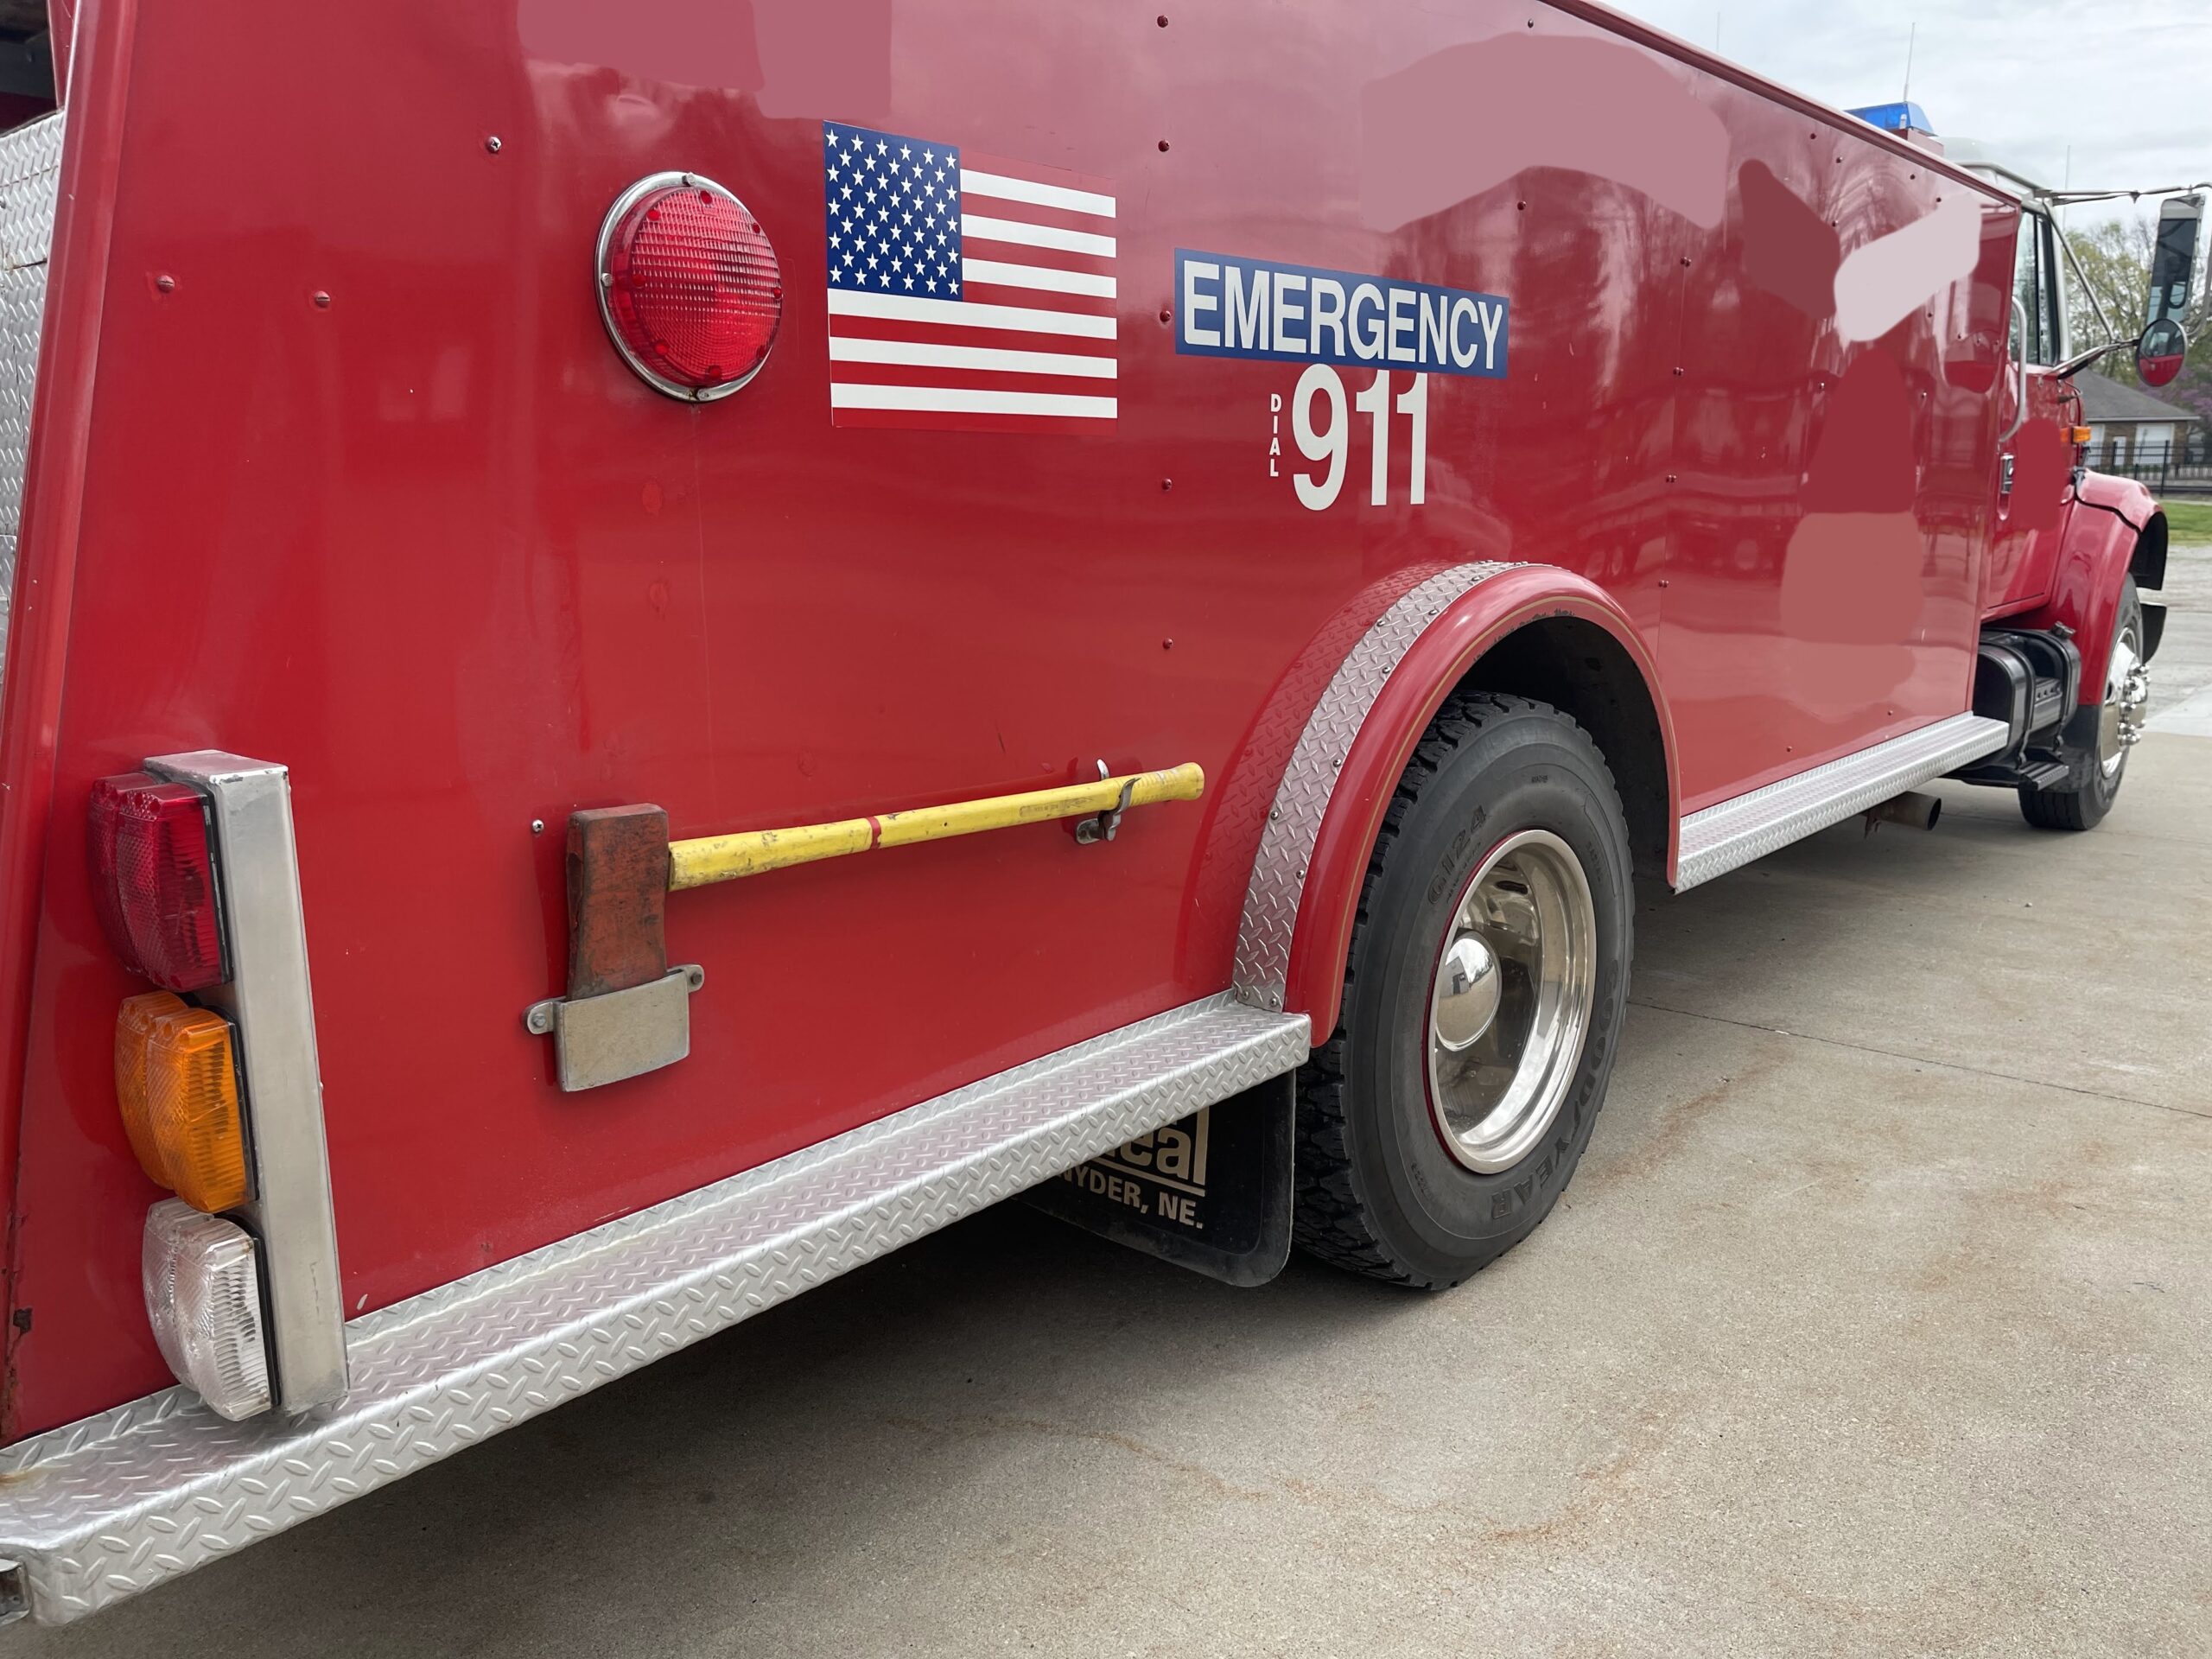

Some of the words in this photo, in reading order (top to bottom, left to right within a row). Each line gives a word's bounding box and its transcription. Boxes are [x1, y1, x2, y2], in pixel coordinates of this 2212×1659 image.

[1183, 259, 1503, 370] EMERGENCY
[1269, 393, 1282, 477] DIAL
[1292, 363, 1428, 512] 911
[1491, 958, 1619, 1220] GOODYEAR
[1104, 1105, 1210, 1185] eal
[1158, 1192, 1205, 1229] NE.
